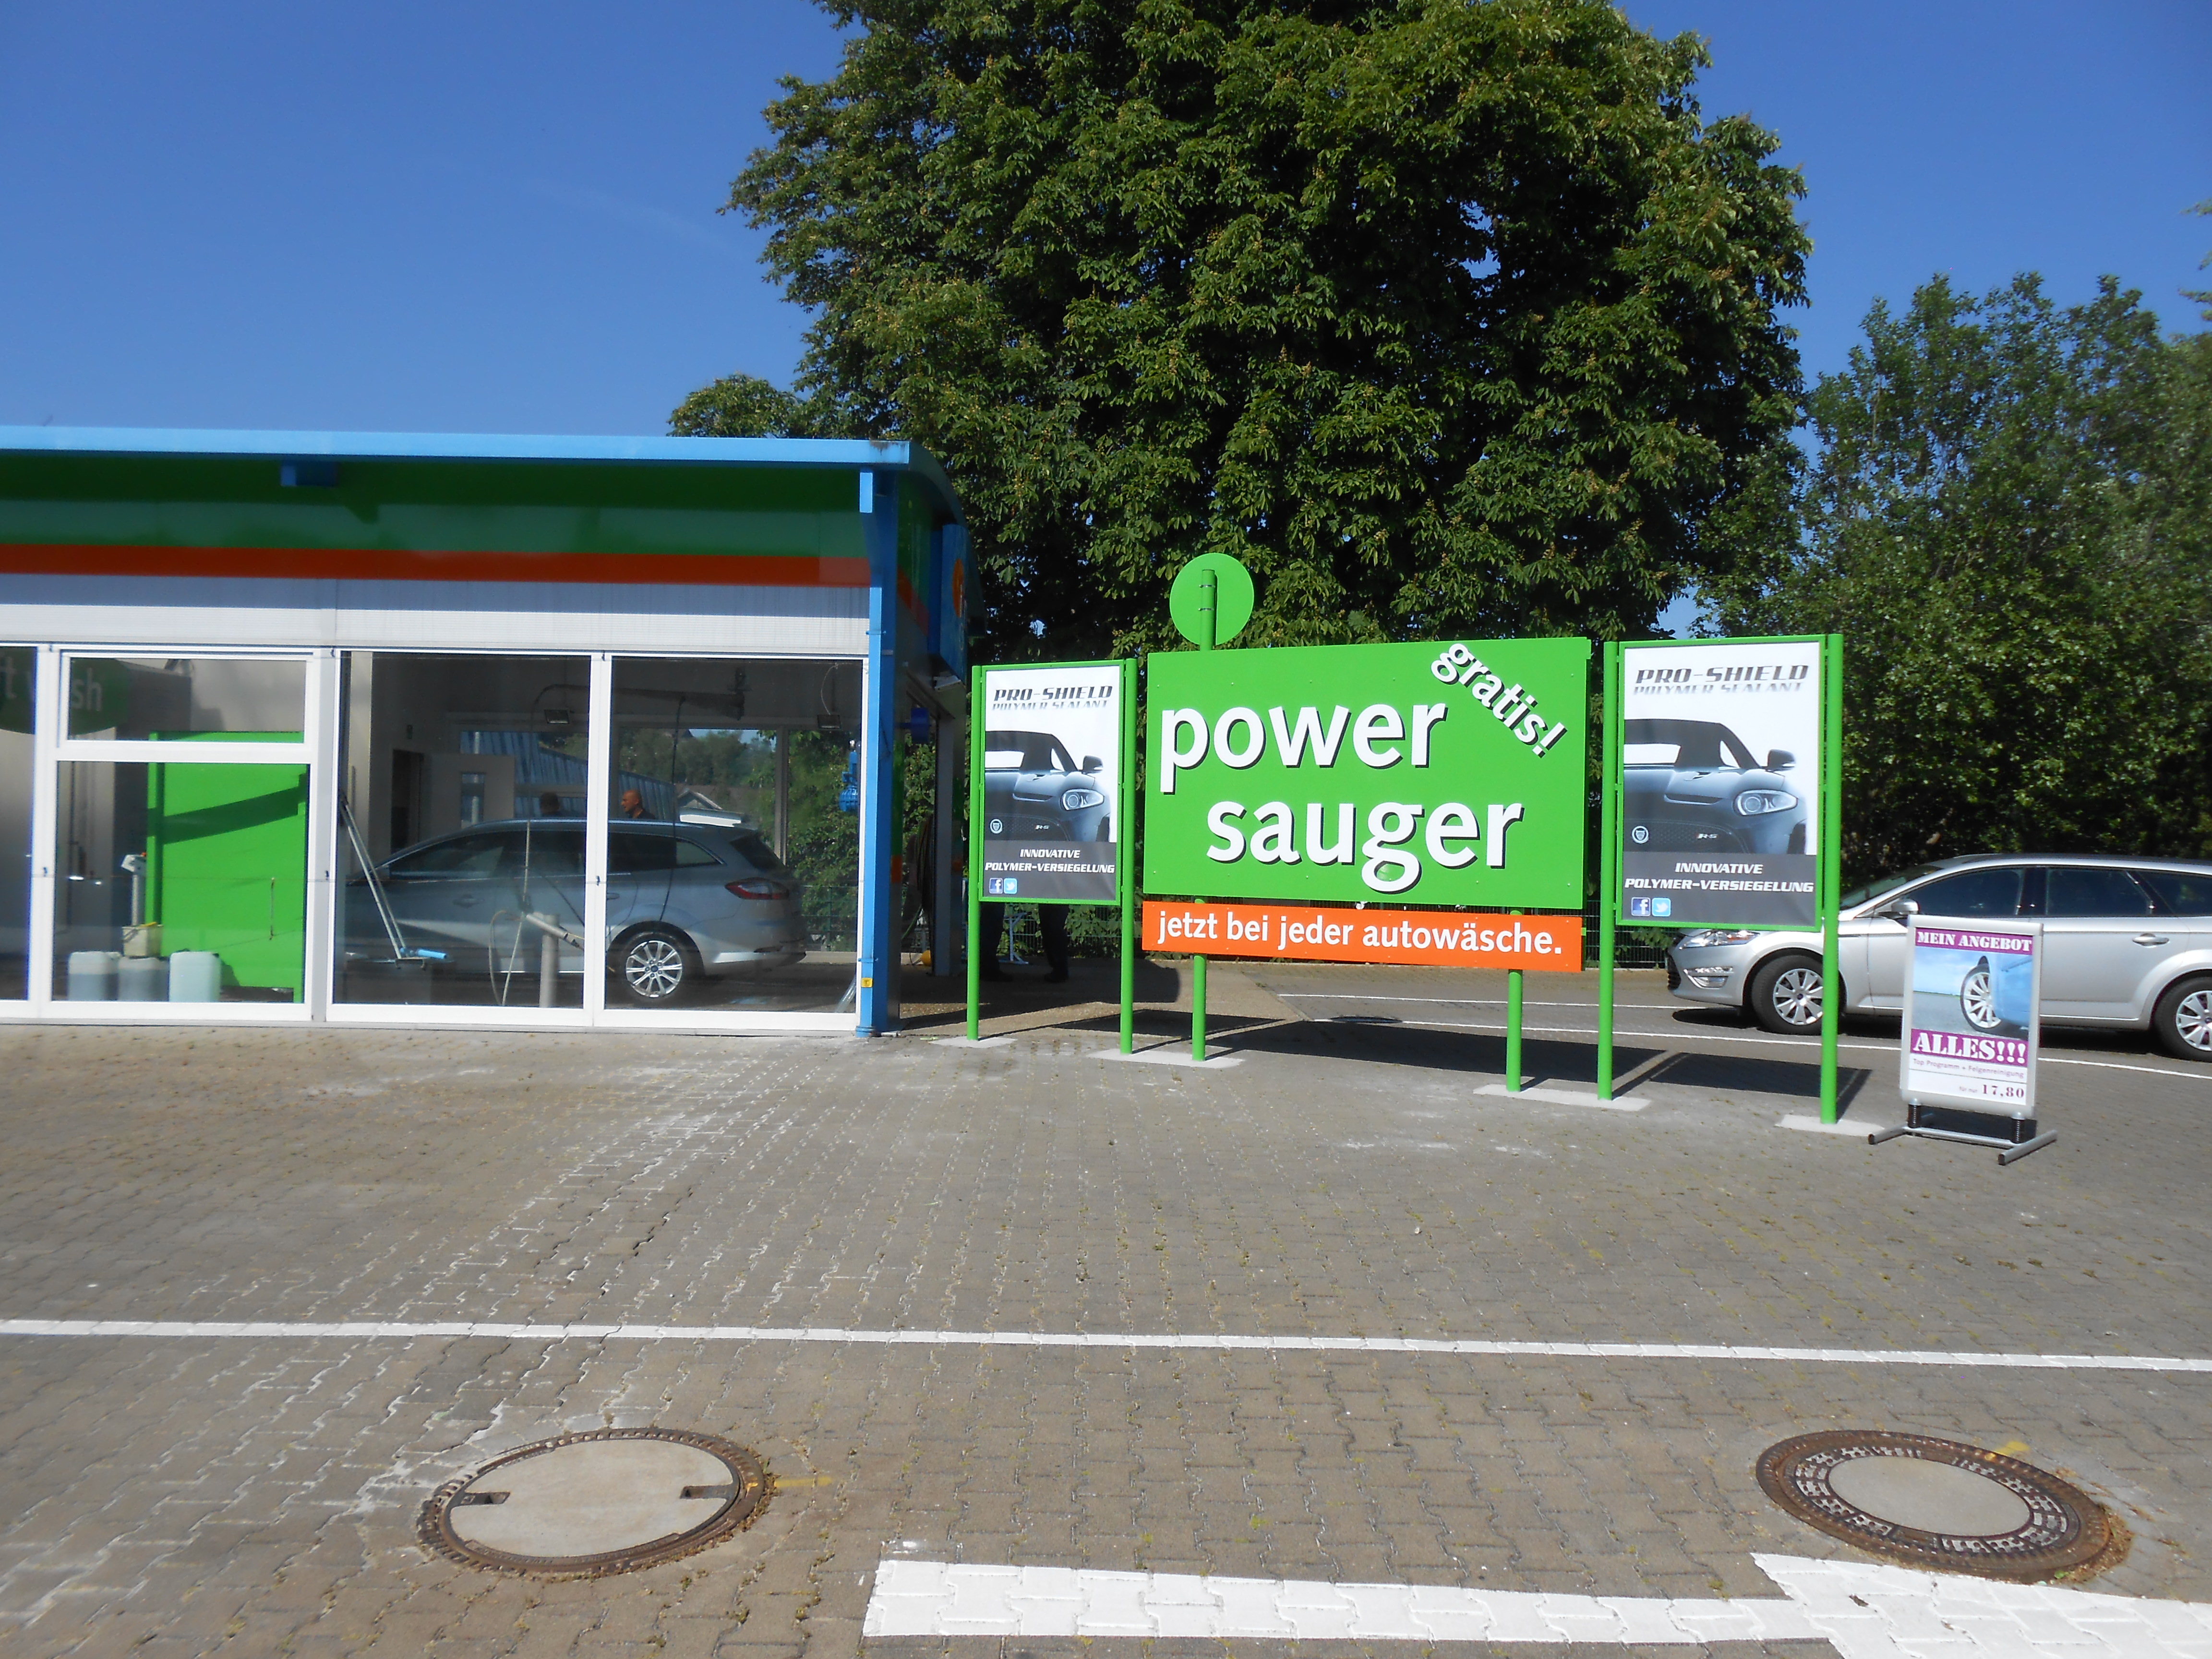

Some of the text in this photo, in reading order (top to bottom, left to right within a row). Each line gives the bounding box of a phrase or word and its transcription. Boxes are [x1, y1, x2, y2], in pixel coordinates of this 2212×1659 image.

[1635, 664, 1809, 684] PRO-SHIELD
[994, 685, 1113, 701] PRO-SHIELD
[1431, 643, 1566, 757] gratis!
[1159, 702, 1447, 794] power
[1019, 848, 1081, 859] INNOVATIVE
[1206, 800, 1523, 893] sauger
[985, 862, 1115, 874] POLYMER-VERSIEGELUNG
[1675, 862, 1763, 874] INNOVATIVE
[1624, 878, 1814, 892] POLYMER-VERSIEGELUNG
[1157, 911, 1562, 954] jetzt bei jeder autowäsche.
[1917, 932, 2032, 951] MEIN ANGEBOT
[1913, 1032, 2027, 1064] ALLES!!!
[1926, 1060, 1960, 1070] Programm
[1968, 1065, 2024, 1079] Felgenreinigung
[1983, 1084, 2024, 1098] 17,80
